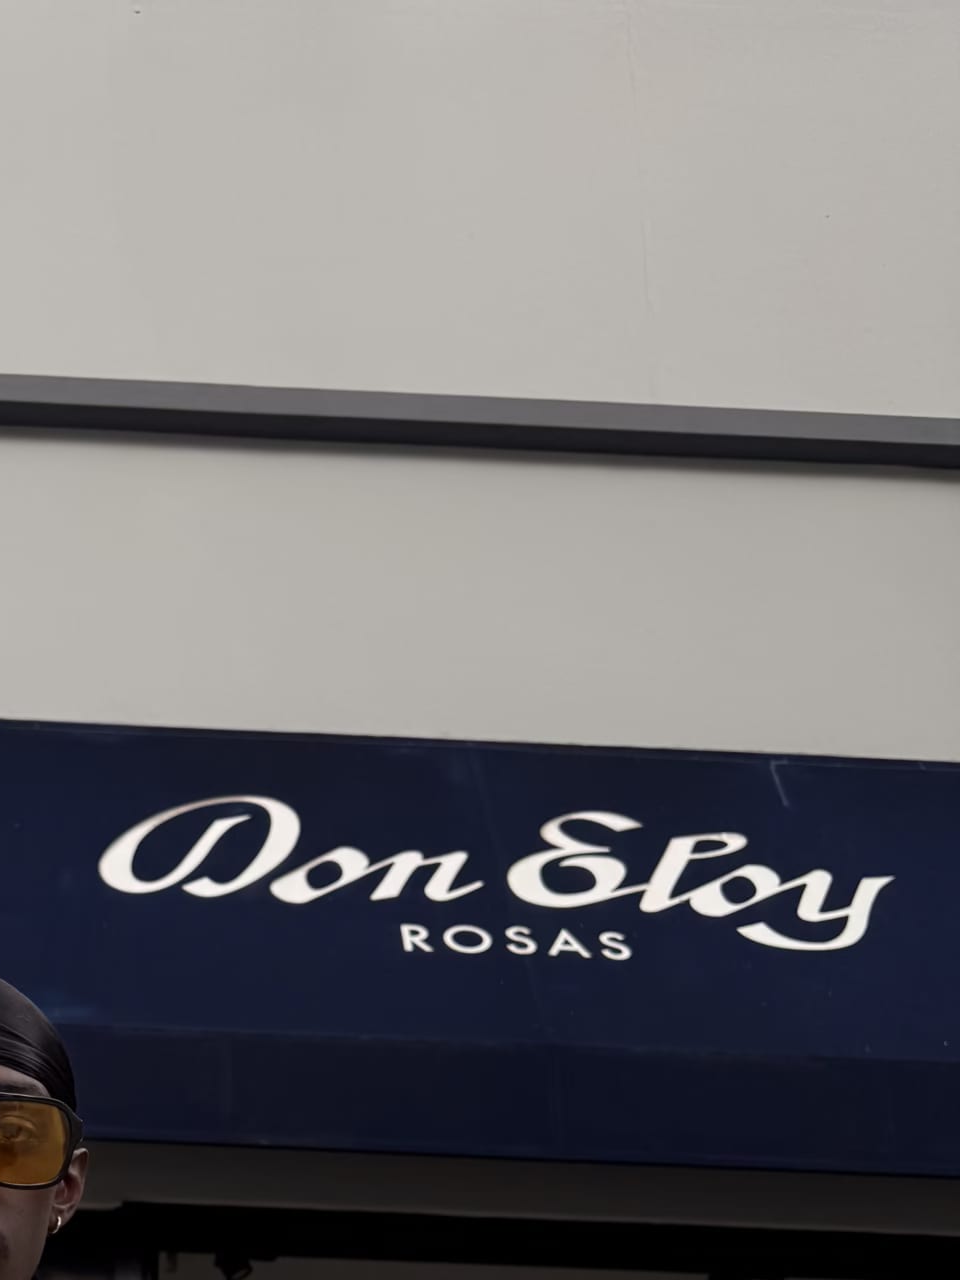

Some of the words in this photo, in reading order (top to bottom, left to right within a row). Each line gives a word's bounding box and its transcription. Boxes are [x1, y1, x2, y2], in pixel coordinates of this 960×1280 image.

[98, 795, 484, 905] Don
[505, 810, 895, 951] Eloy
[399, 923, 632, 961] ROSAS
